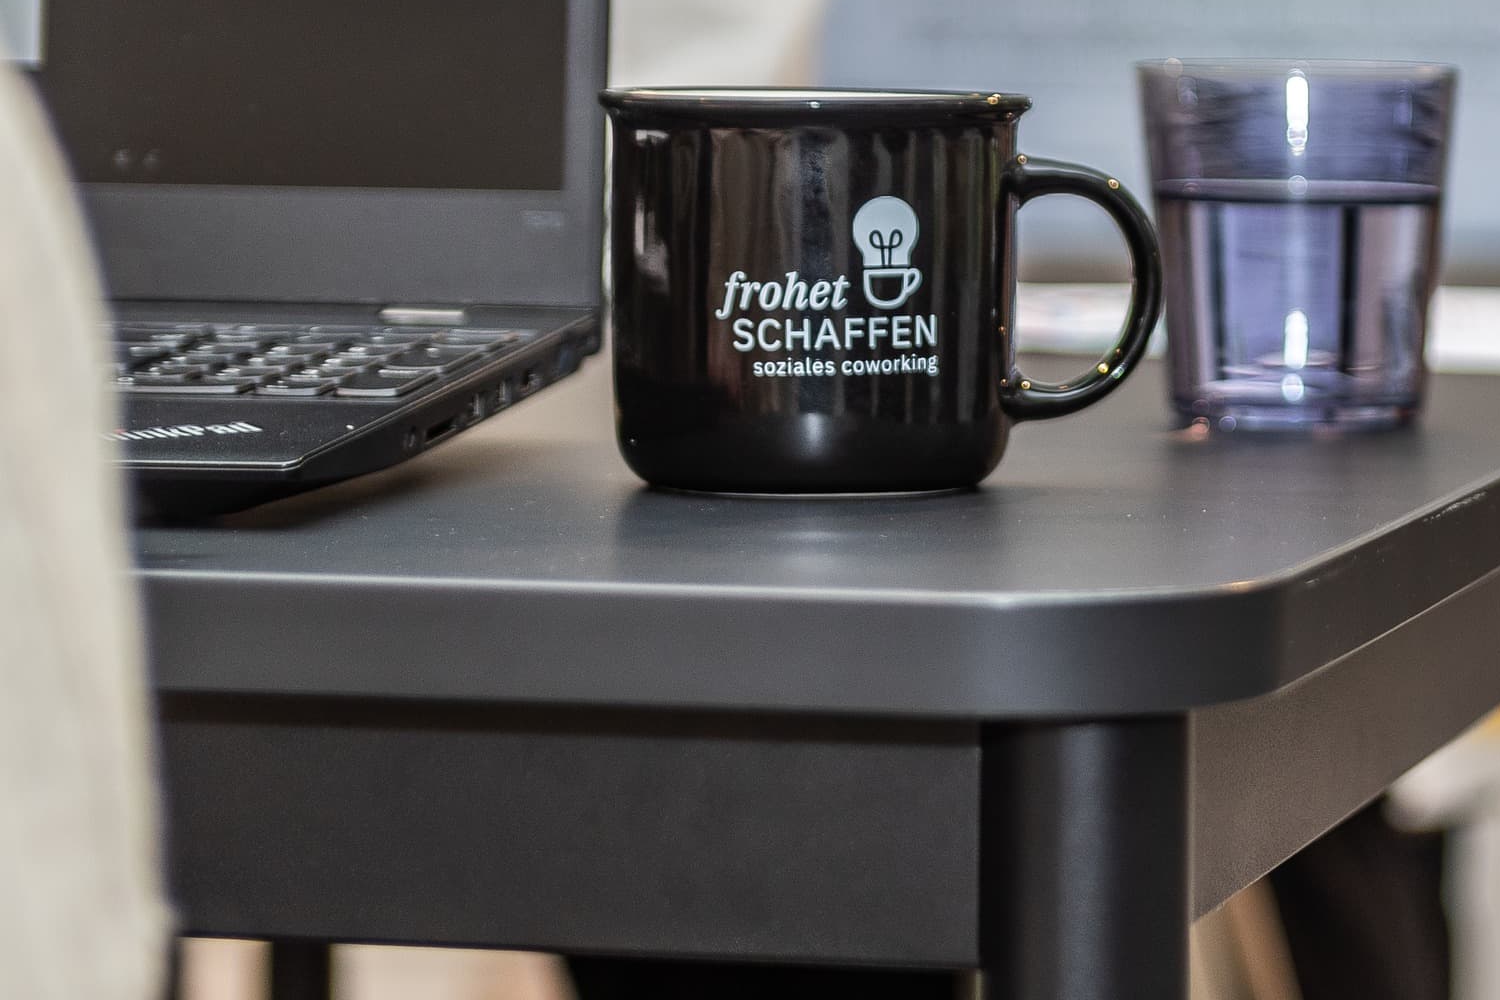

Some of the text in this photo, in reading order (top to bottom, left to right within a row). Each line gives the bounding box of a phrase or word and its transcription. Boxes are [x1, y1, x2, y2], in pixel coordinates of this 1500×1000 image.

[716, 271, 850, 320] frohet
[733, 315, 937, 352] SCHAFFEN
[754, 353, 938, 377] soziales coworking
[103, 421, 263, 441] inkPad
